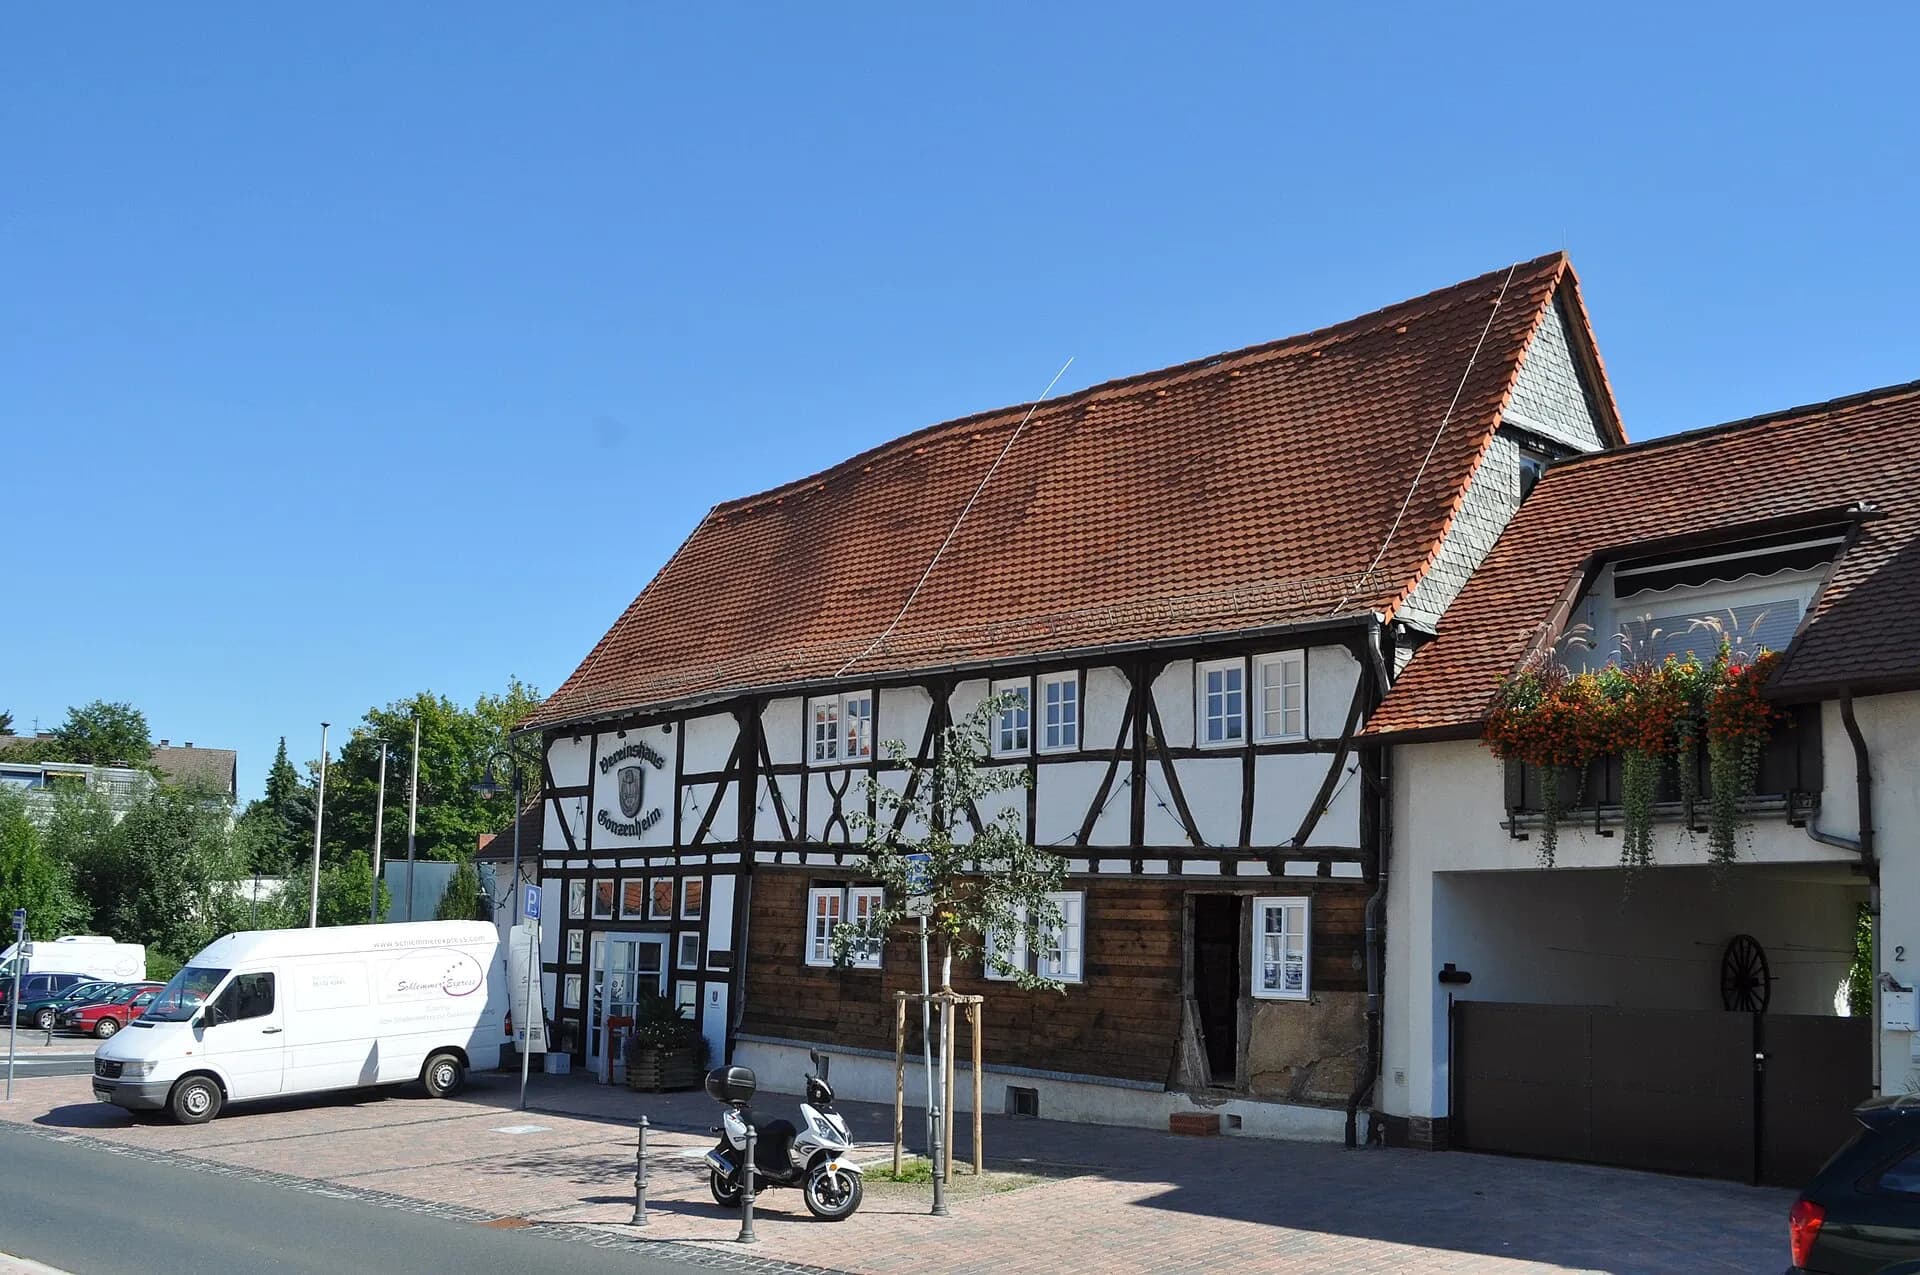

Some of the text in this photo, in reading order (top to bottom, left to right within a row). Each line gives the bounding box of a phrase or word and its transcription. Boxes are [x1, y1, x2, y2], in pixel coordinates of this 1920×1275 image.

[599, 740, 665, 775] Vereinshaus
[597, 807, 662, 841] Gonzenheim
[528, 889, 537, 913] P
[1895, 945, 1905, 962] 2
[397, 980, 443, 992] Schlemmer
